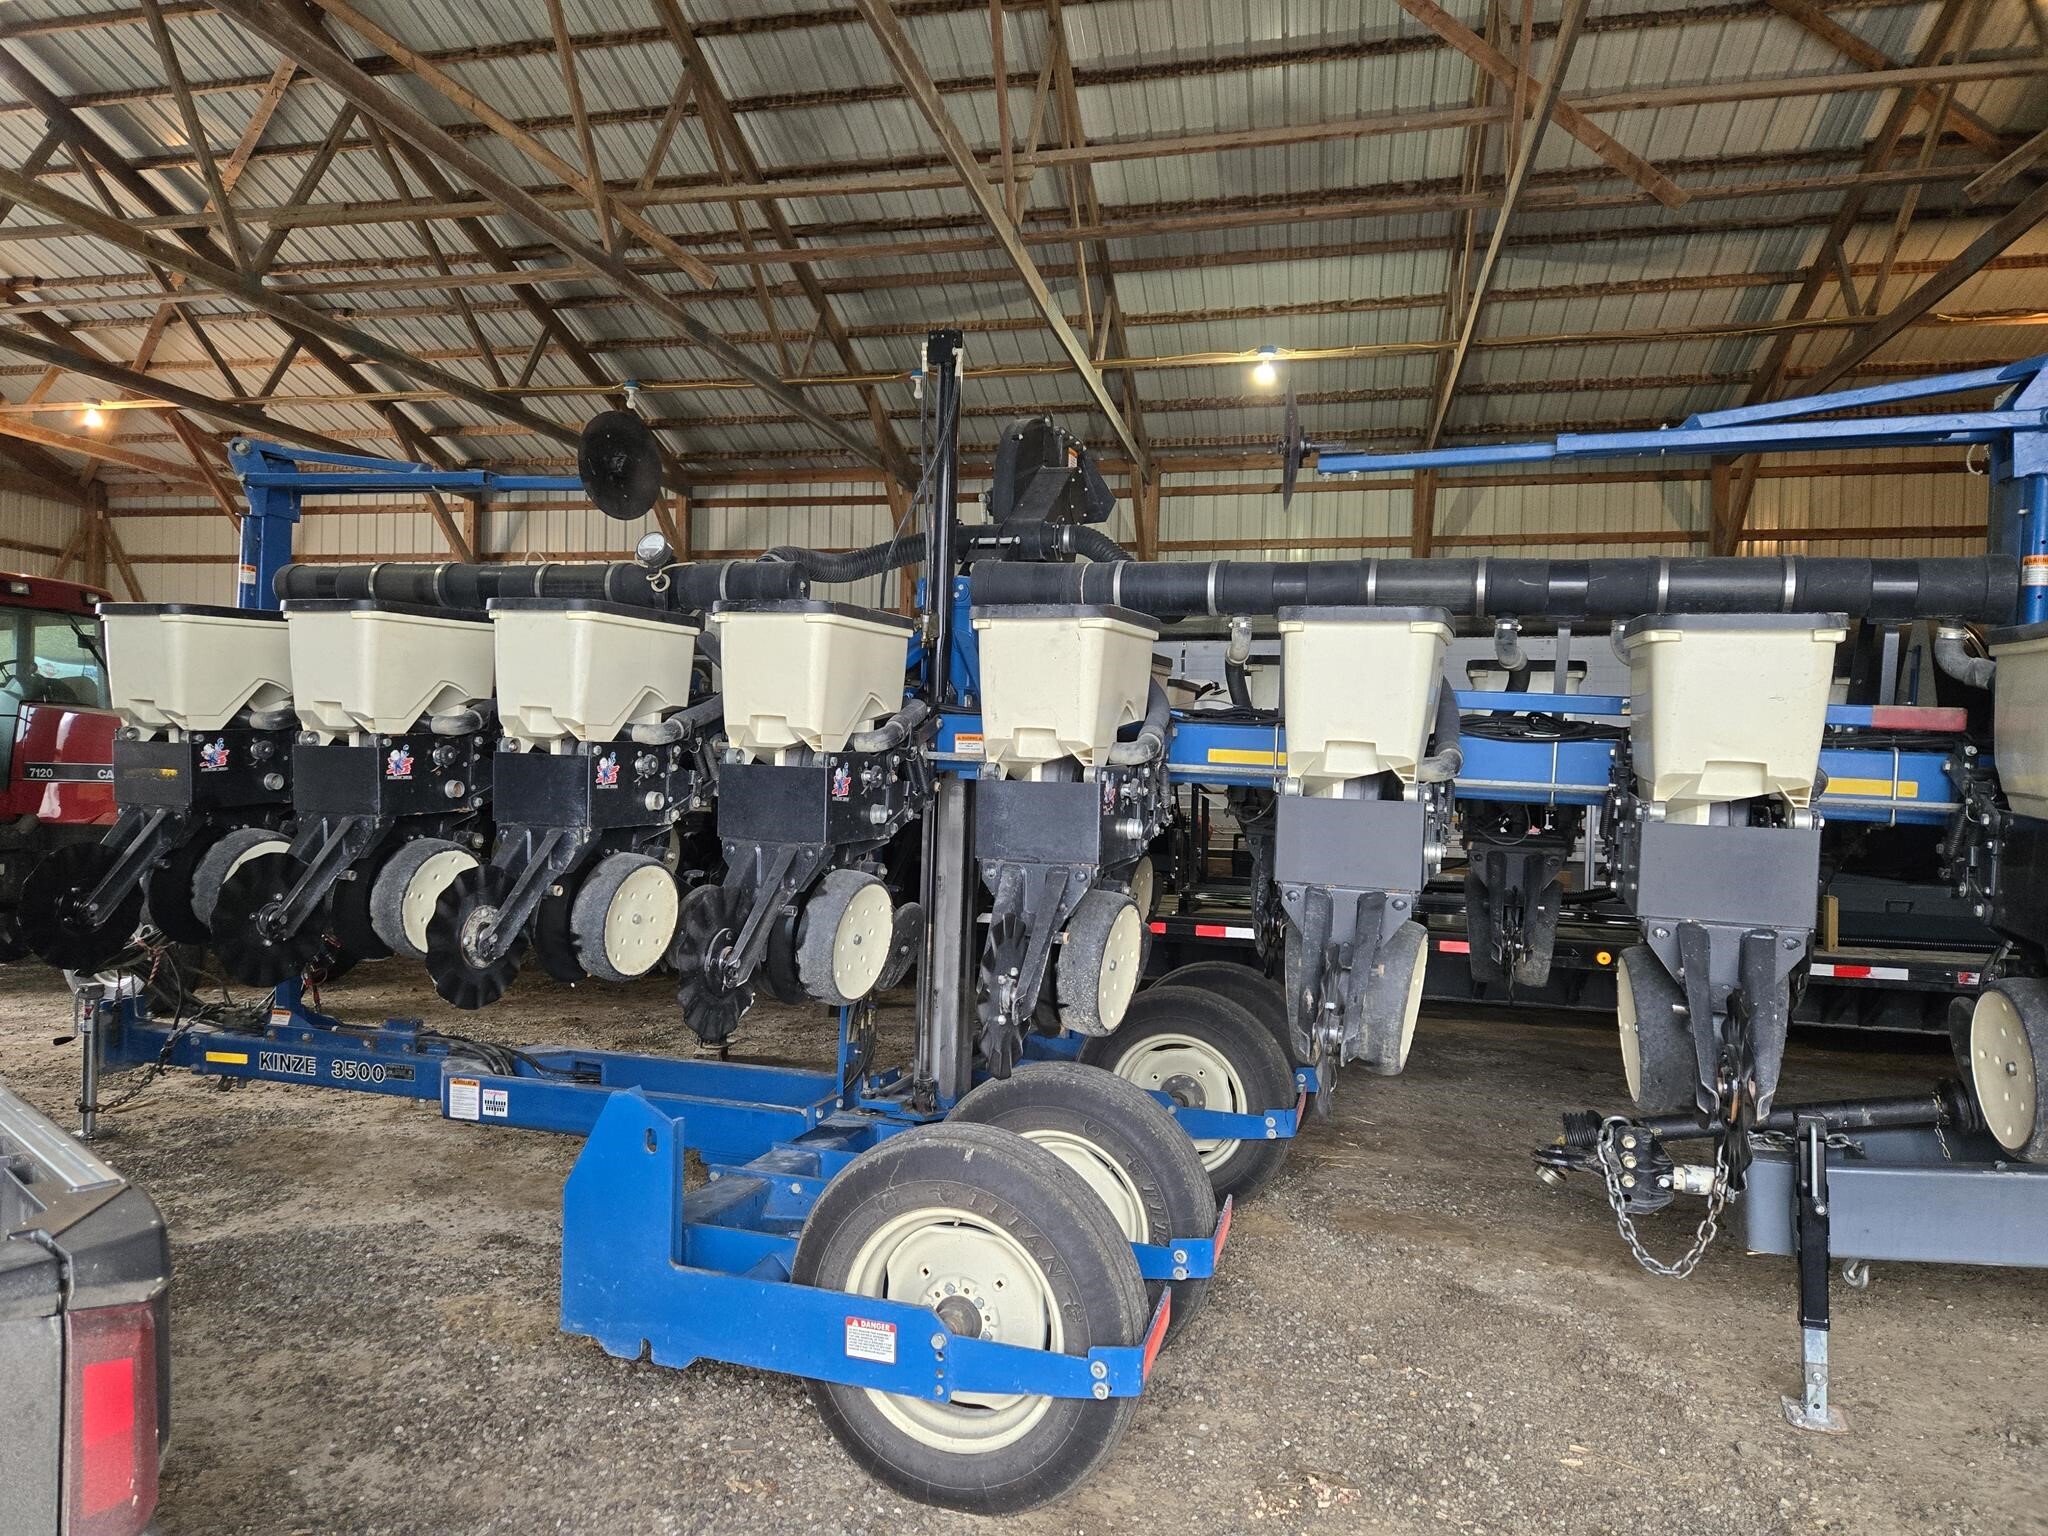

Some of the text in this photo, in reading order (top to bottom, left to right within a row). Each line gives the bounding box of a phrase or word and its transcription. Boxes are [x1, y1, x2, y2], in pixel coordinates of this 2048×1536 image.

[29, 768, 54, 778] 7120
[97, 769, 114, 779] CA
[259, 1051, 316, 1076] KINZE
[331, 1059, 386, 1084] 3500
[860, 1319, 891, 1332] DANGER
